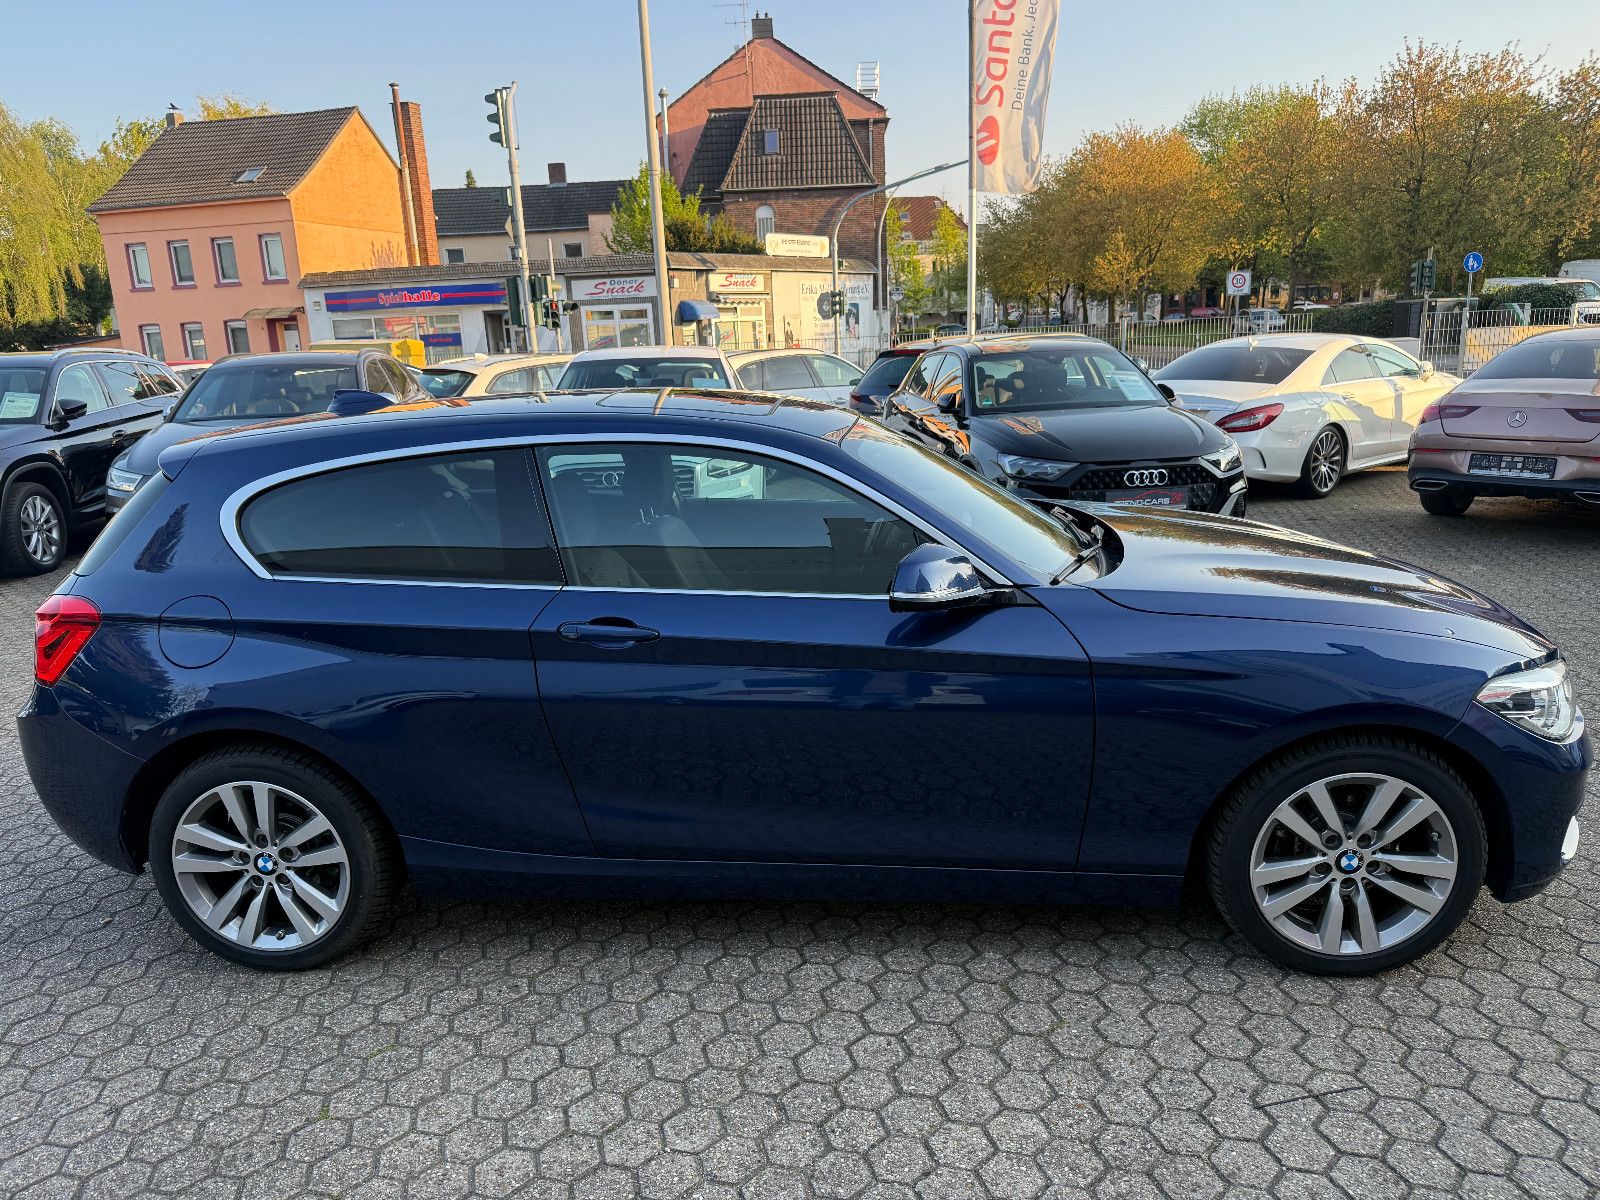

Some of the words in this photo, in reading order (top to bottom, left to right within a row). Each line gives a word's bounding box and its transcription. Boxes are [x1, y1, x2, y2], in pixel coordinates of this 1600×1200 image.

[1017, 25, 1036, 65] Bank.
[1011, 69, 1028, 111] Deine
[584, 280, 645, 296] Snack
[719, 273, 758, 288] Snack
[1234, 277, 1244, 285] 30
[801, 283, 818, 295] Erika
[378, 290, 441, 306] Spielhalle
